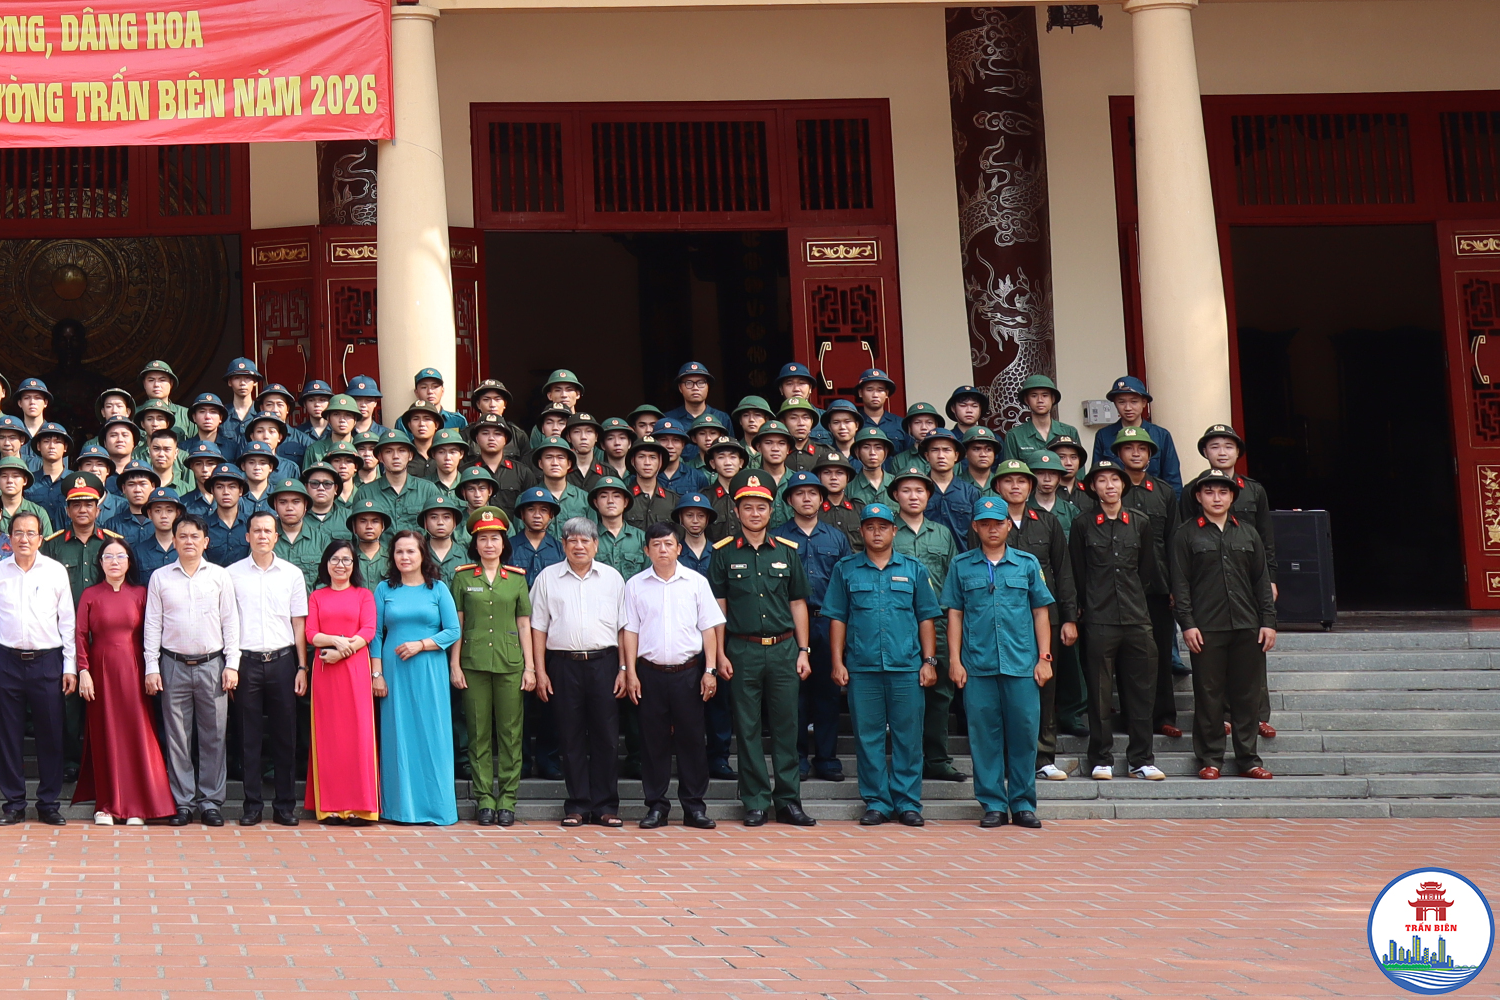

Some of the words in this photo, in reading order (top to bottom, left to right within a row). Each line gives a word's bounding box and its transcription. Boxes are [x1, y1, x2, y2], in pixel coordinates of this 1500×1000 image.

[60, 6, 139, 52] DÂNG
[145, 10, 205, 50] HOA
[70, 66, 150, 123] TRẤN
[157, 70, 226, 121] BIÊN
[232, 68, 303, 118] NĂM
[310, 73, 378, 116] 2026
